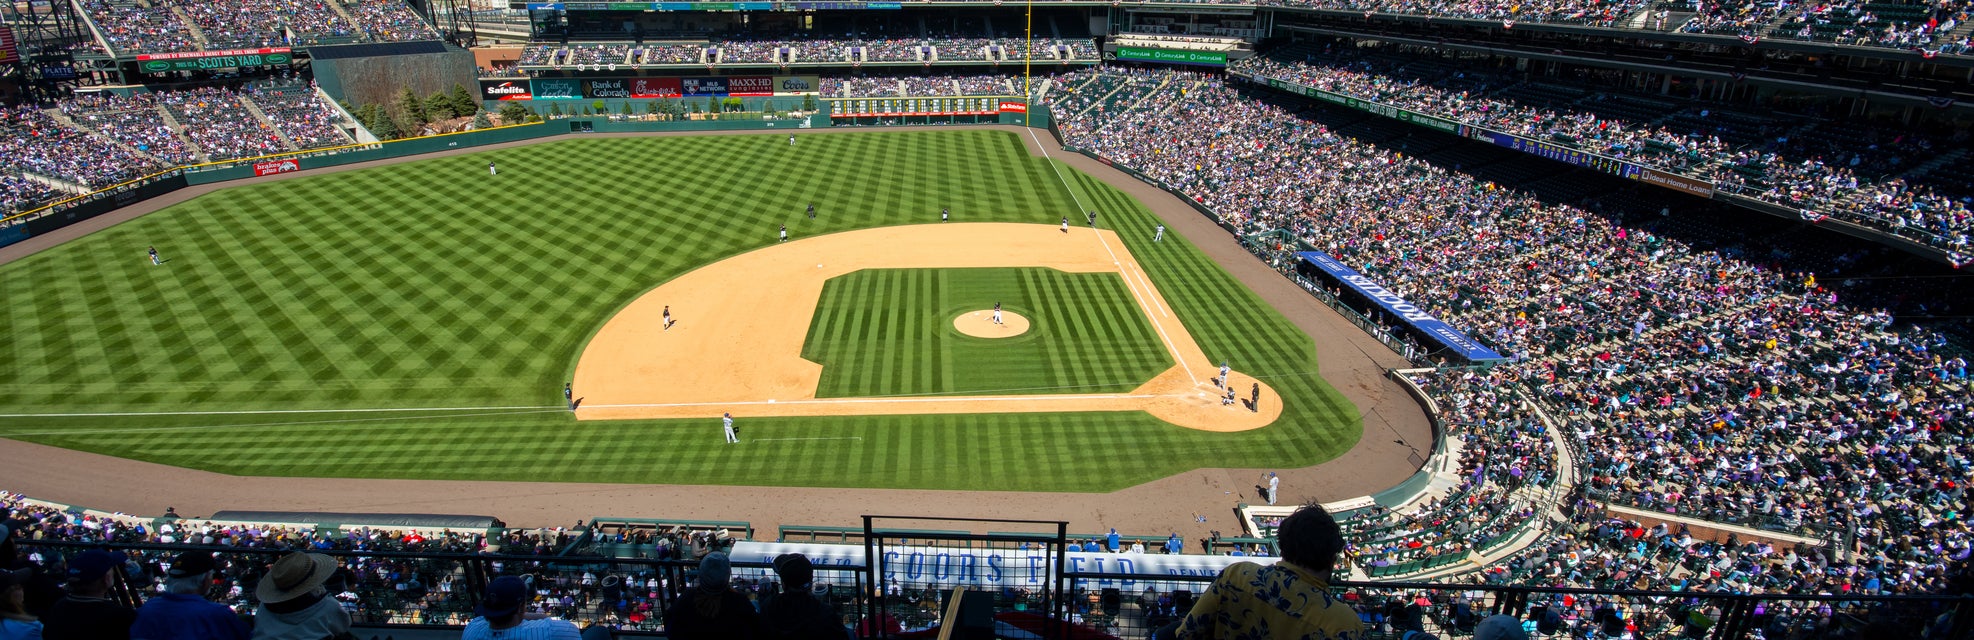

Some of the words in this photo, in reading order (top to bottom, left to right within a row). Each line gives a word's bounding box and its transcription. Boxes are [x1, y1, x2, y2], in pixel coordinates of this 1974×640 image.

[200, 56, 236, 69] SCOTTS
[238, 55, 262, 66] YARD
[488, 86, 524, 94] Safelite
[593, 89, 630, 97] Colorado
[782, 80, 809, 90] Coors
[1649, 174, 1665, 183] Ideal
[1667, 179, 1687, 189] Home
[1689, 184, 1711, 194] Loans
[1342, 274, 1438, 322] ROCKIES
[884, 551, 1002, 582] COORS
[1028, 556, 1136, 585] FELD
